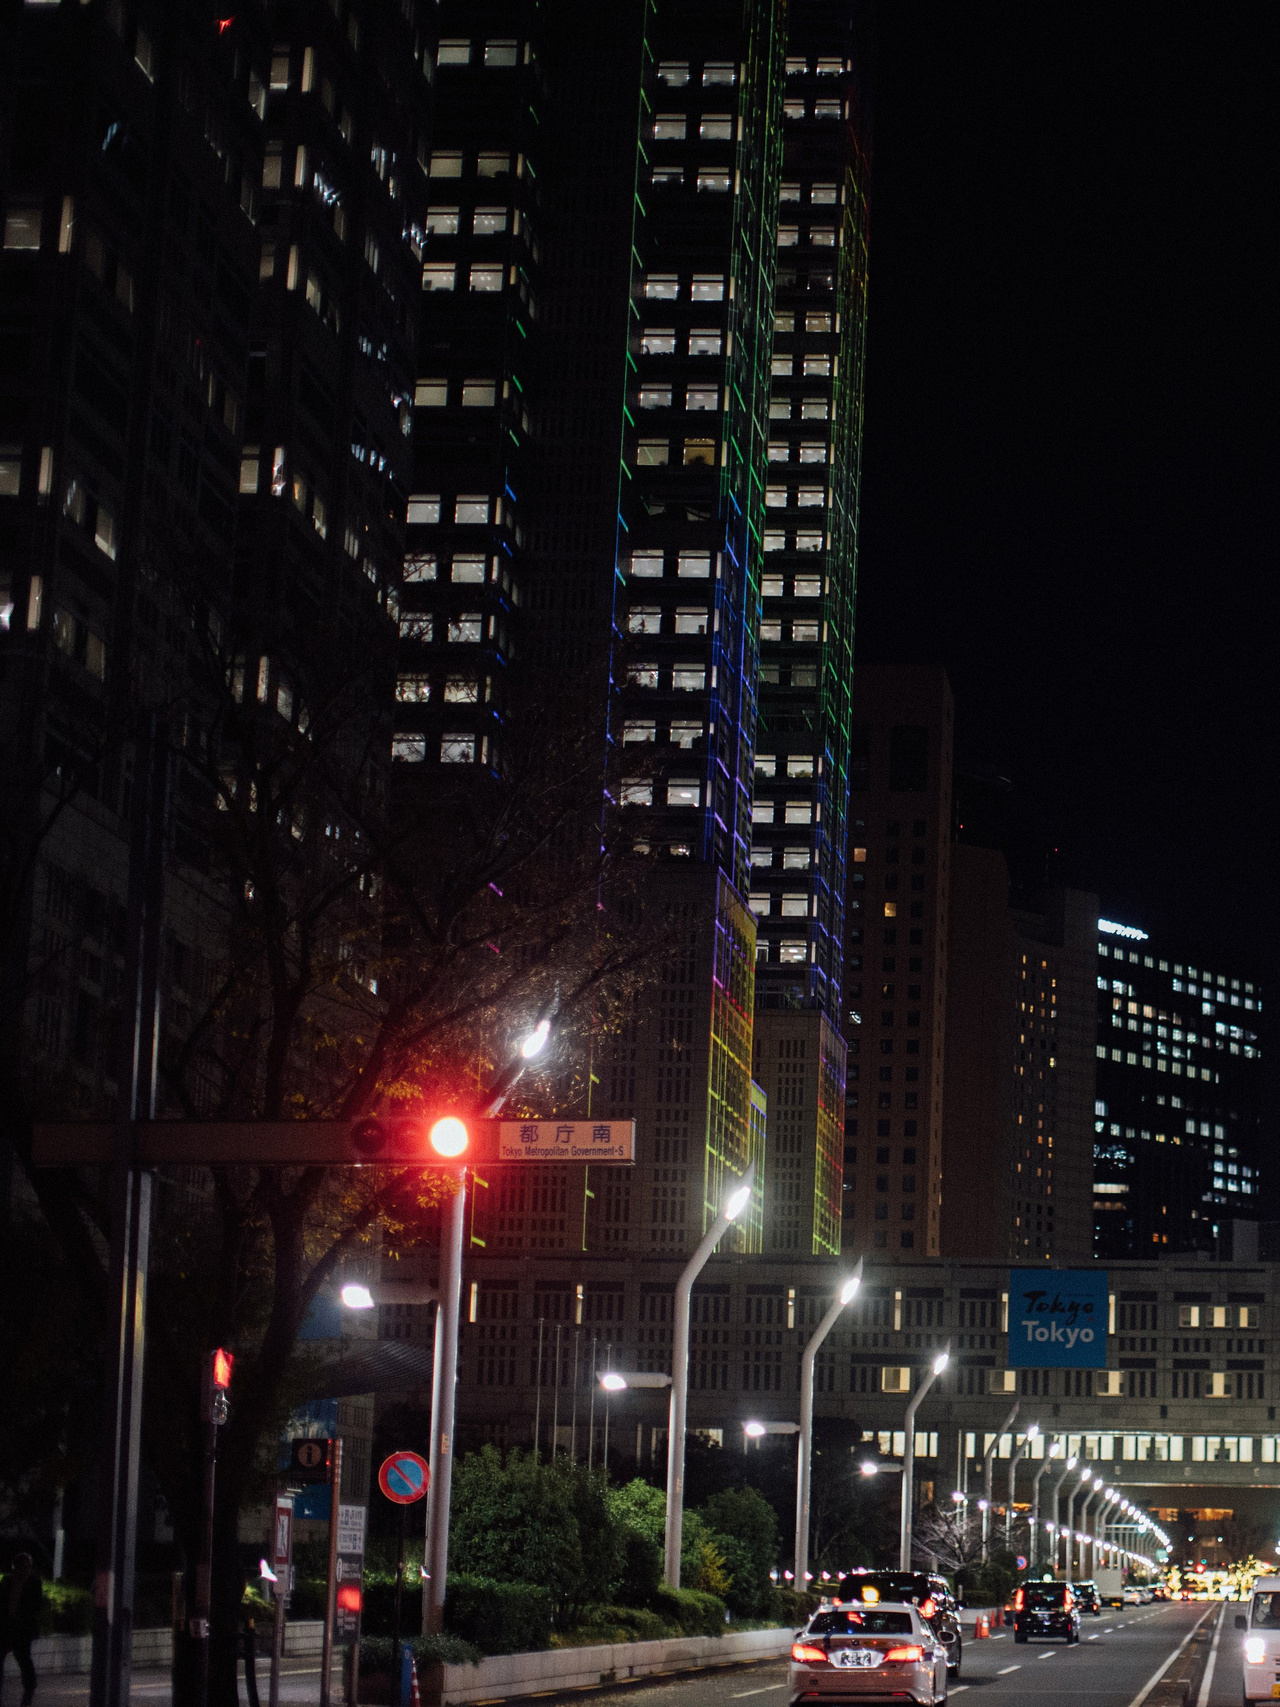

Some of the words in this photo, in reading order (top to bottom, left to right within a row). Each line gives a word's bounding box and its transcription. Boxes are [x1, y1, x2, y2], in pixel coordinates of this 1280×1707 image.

[520, 1124, 611, 1144] 都庁南
[501, 1146, 522, 1158] Tokyo
[525, 1146, 569, 1158] Metropolitan
[1023, 1290, 1094, 1325] Tokyo
[1021, 1320, 1094, 1348] Tokyo
